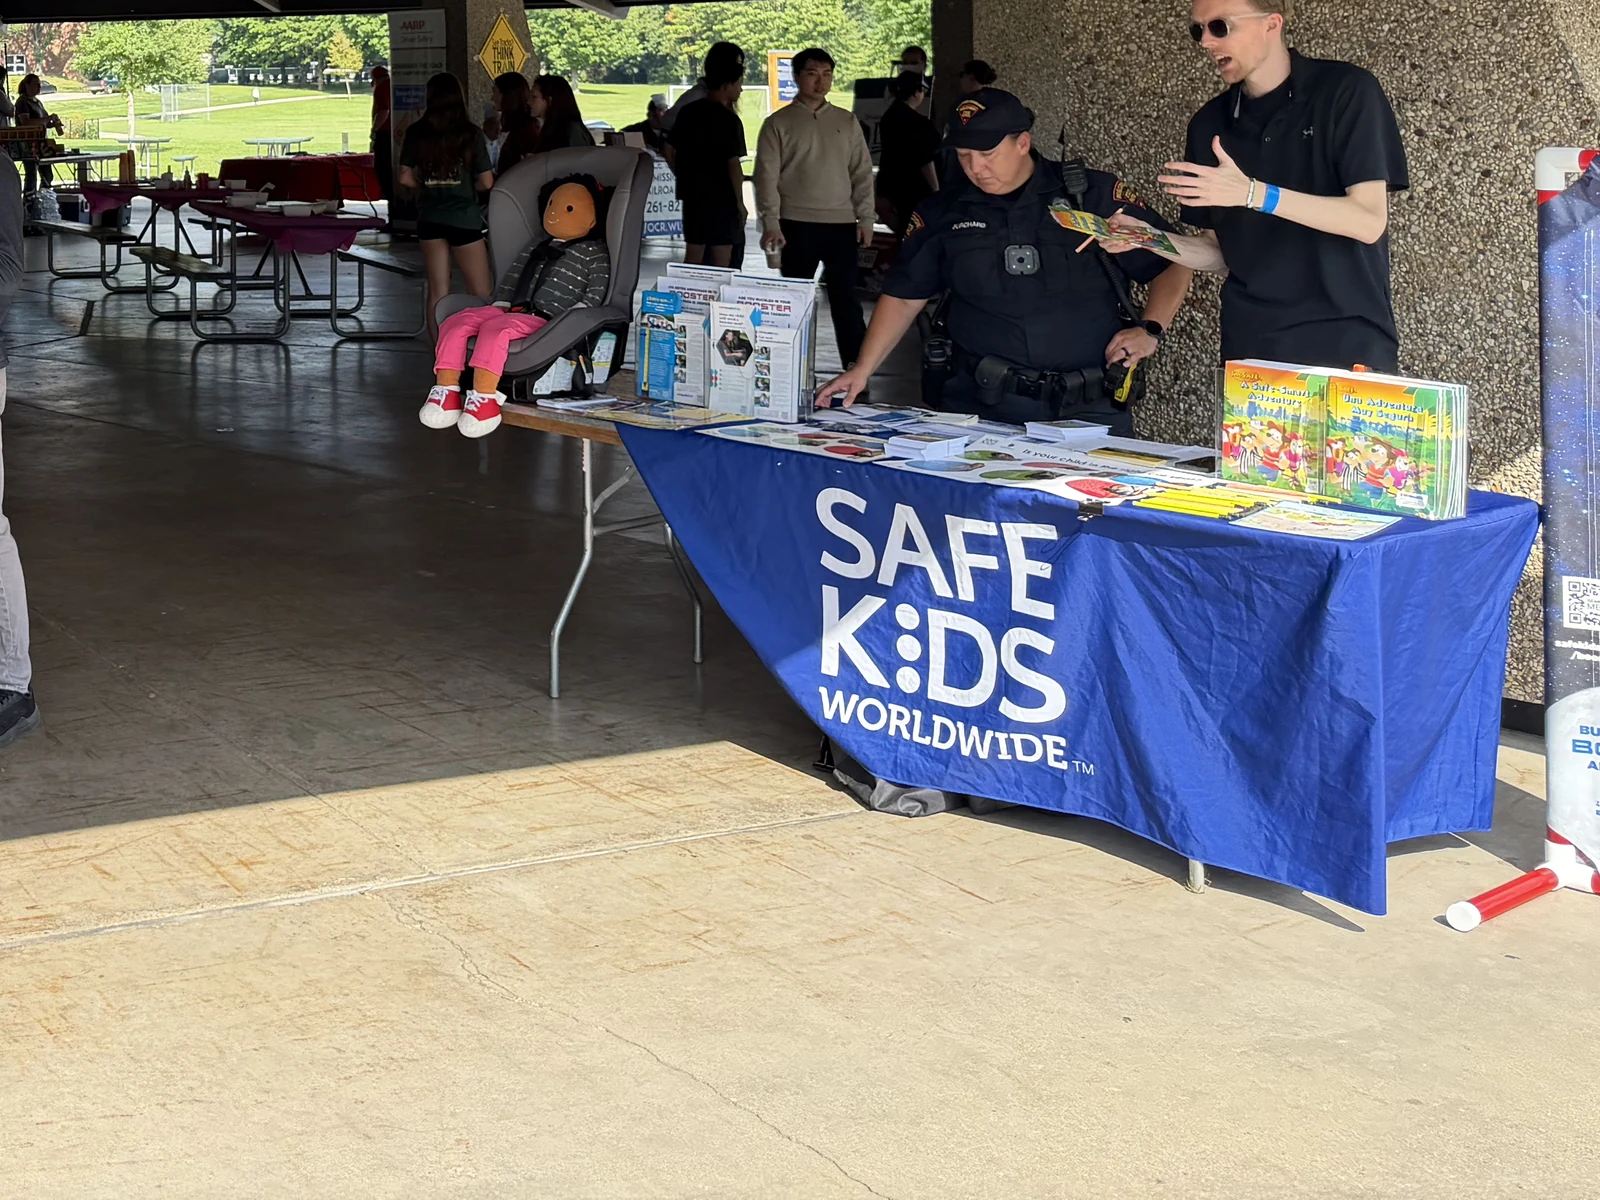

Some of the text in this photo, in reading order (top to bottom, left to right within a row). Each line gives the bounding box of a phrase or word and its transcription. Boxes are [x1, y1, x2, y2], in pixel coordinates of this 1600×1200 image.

[492, 47, 515, 60] THINK
[492, 60, 516, 74] TRAIN
[646, 200, 681, 213] 261-82
[1240, 380, 1250, 389] A
[1247, 391, 1302, 407] Adventure
[1033, 451, 1058, 461] your
[1059, 456, 1088, 466] child
[815, 487, 1058, 621] SAFE
[818, 686, 1069, 771] WORLDWIDE
